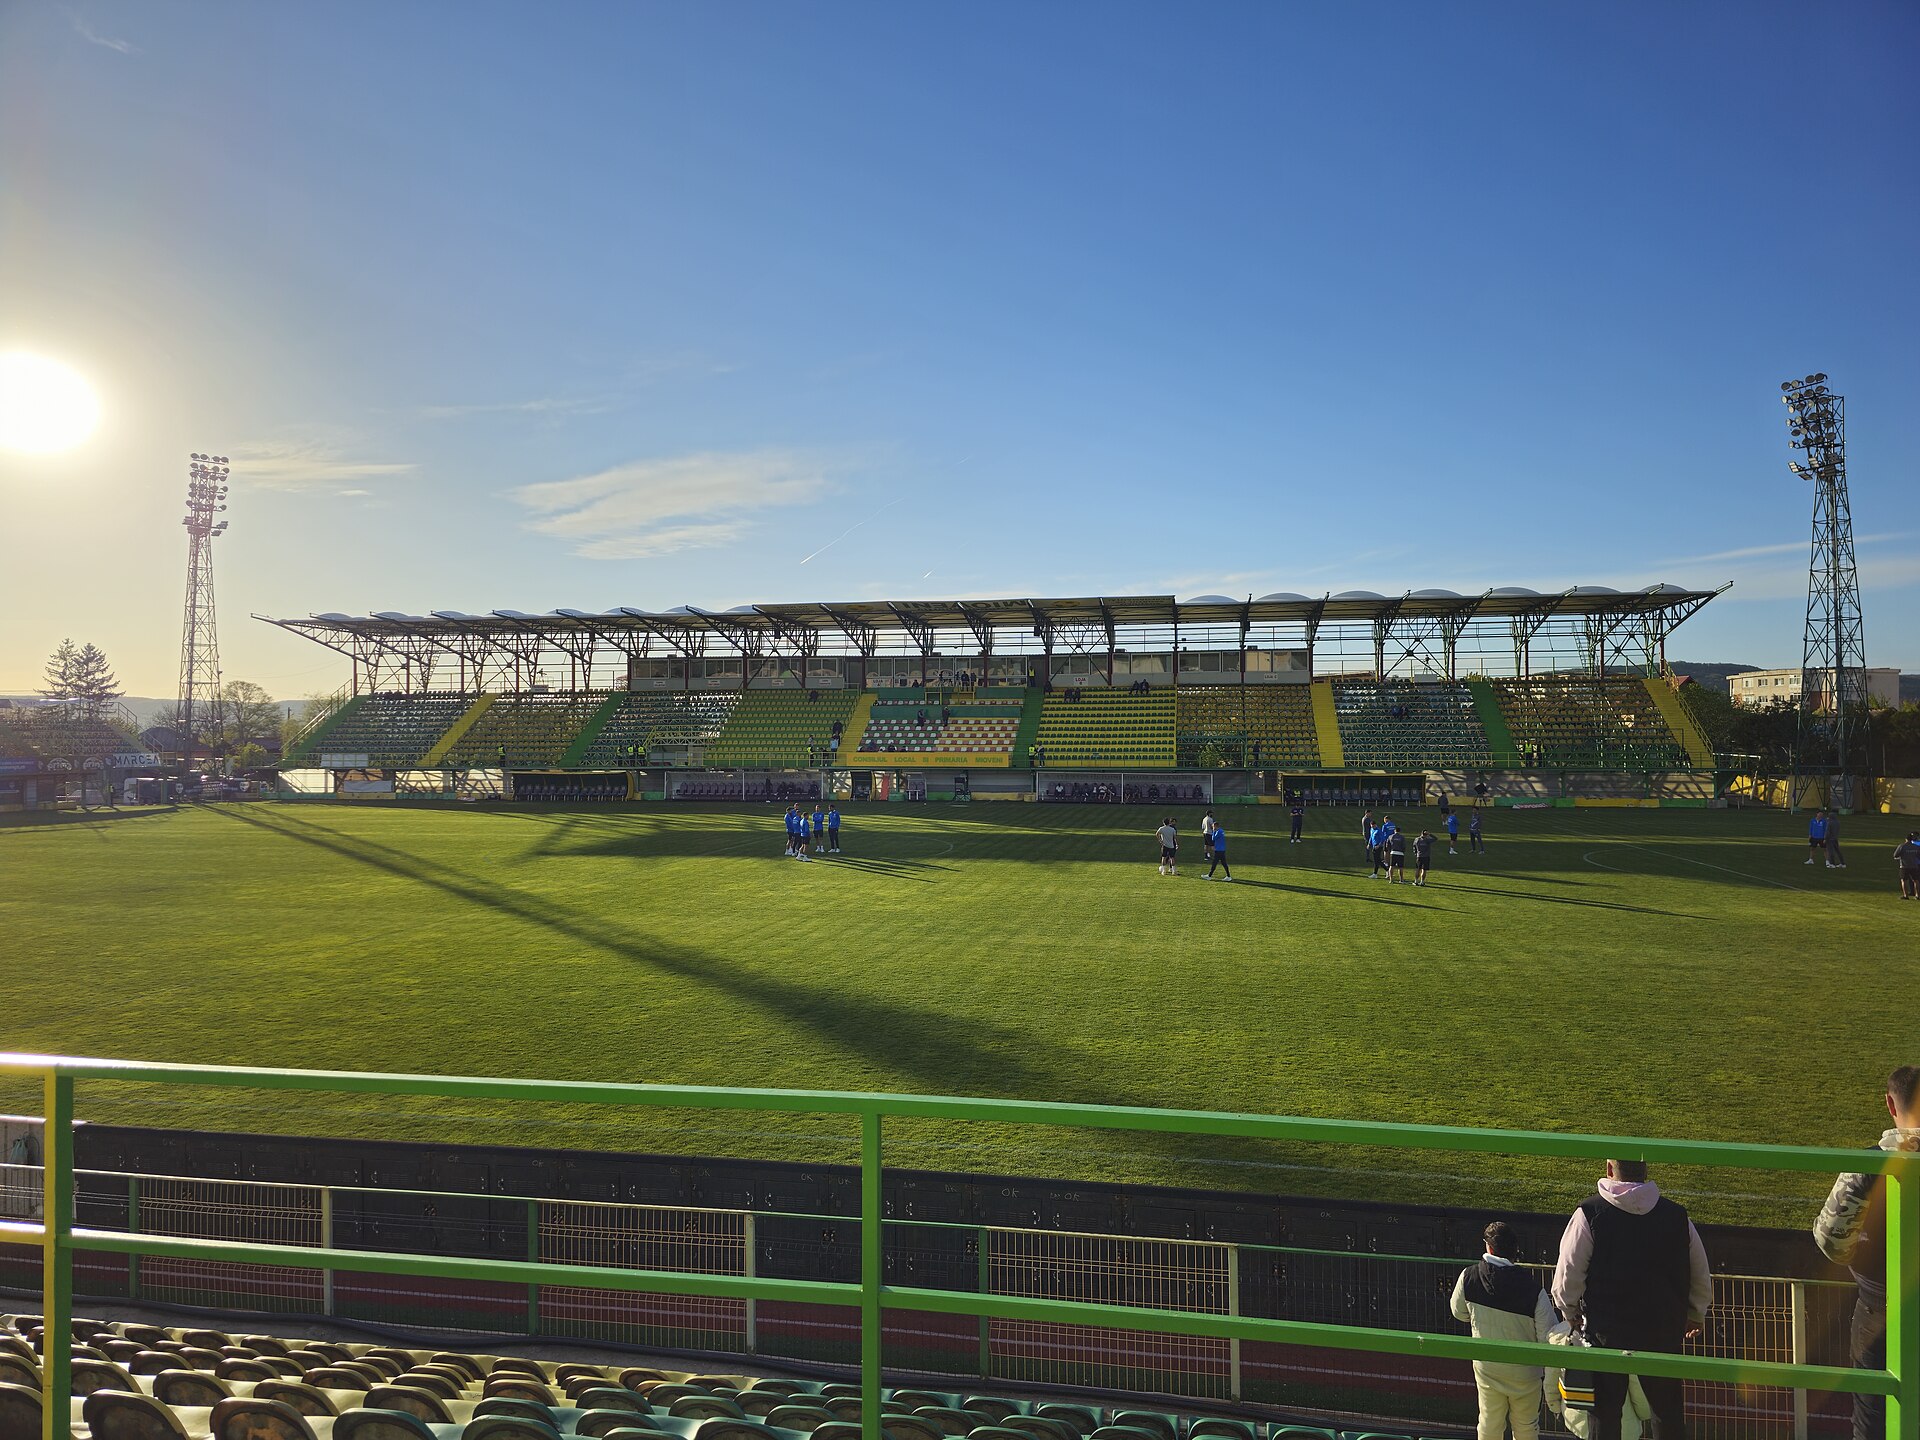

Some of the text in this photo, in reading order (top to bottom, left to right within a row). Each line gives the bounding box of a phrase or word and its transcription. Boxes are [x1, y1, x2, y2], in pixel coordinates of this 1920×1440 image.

[114, 755, 161, 765] MARCEA
[1001, 1187, 1019, 1198] OK
[1064, 1192, 1080, 1202] OK
[1387, 1215, 1399, 1224] OK
